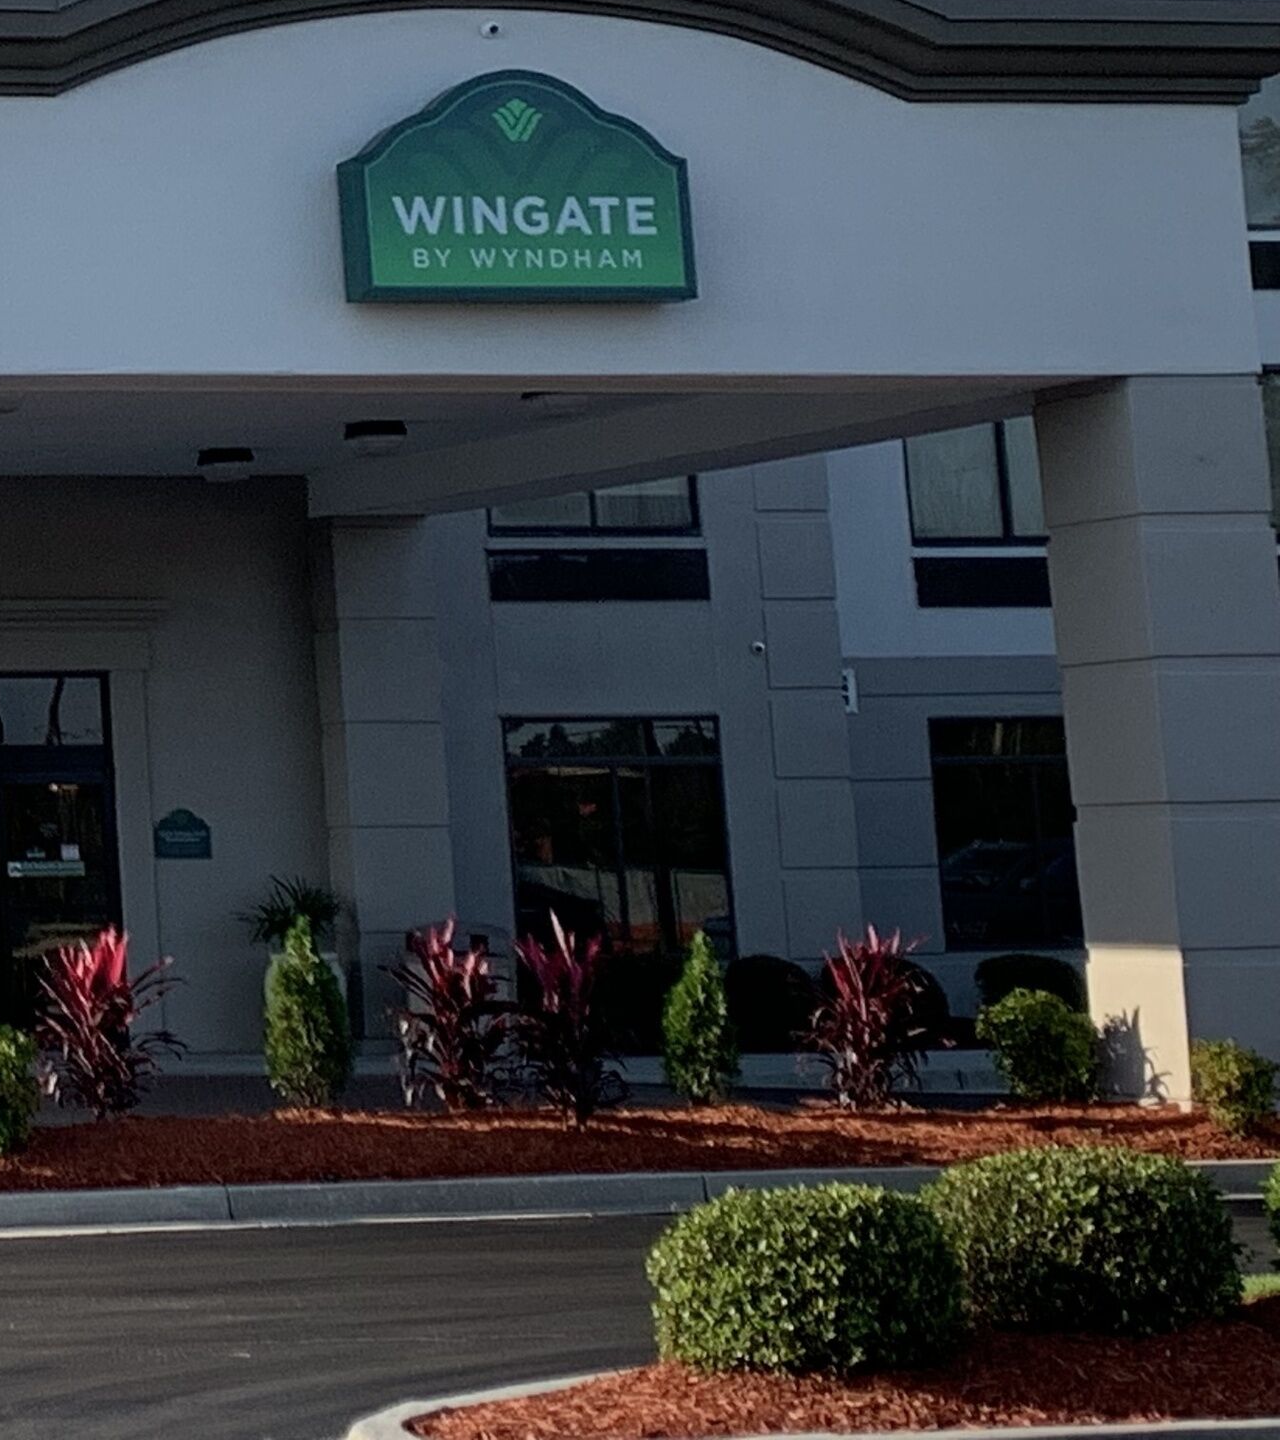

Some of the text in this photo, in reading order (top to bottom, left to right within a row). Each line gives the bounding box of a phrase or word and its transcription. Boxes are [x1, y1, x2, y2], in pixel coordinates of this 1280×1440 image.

[392, 195, 658, 236] WINGATE
[413, 248, 643, 269] BY WYNDHAM
